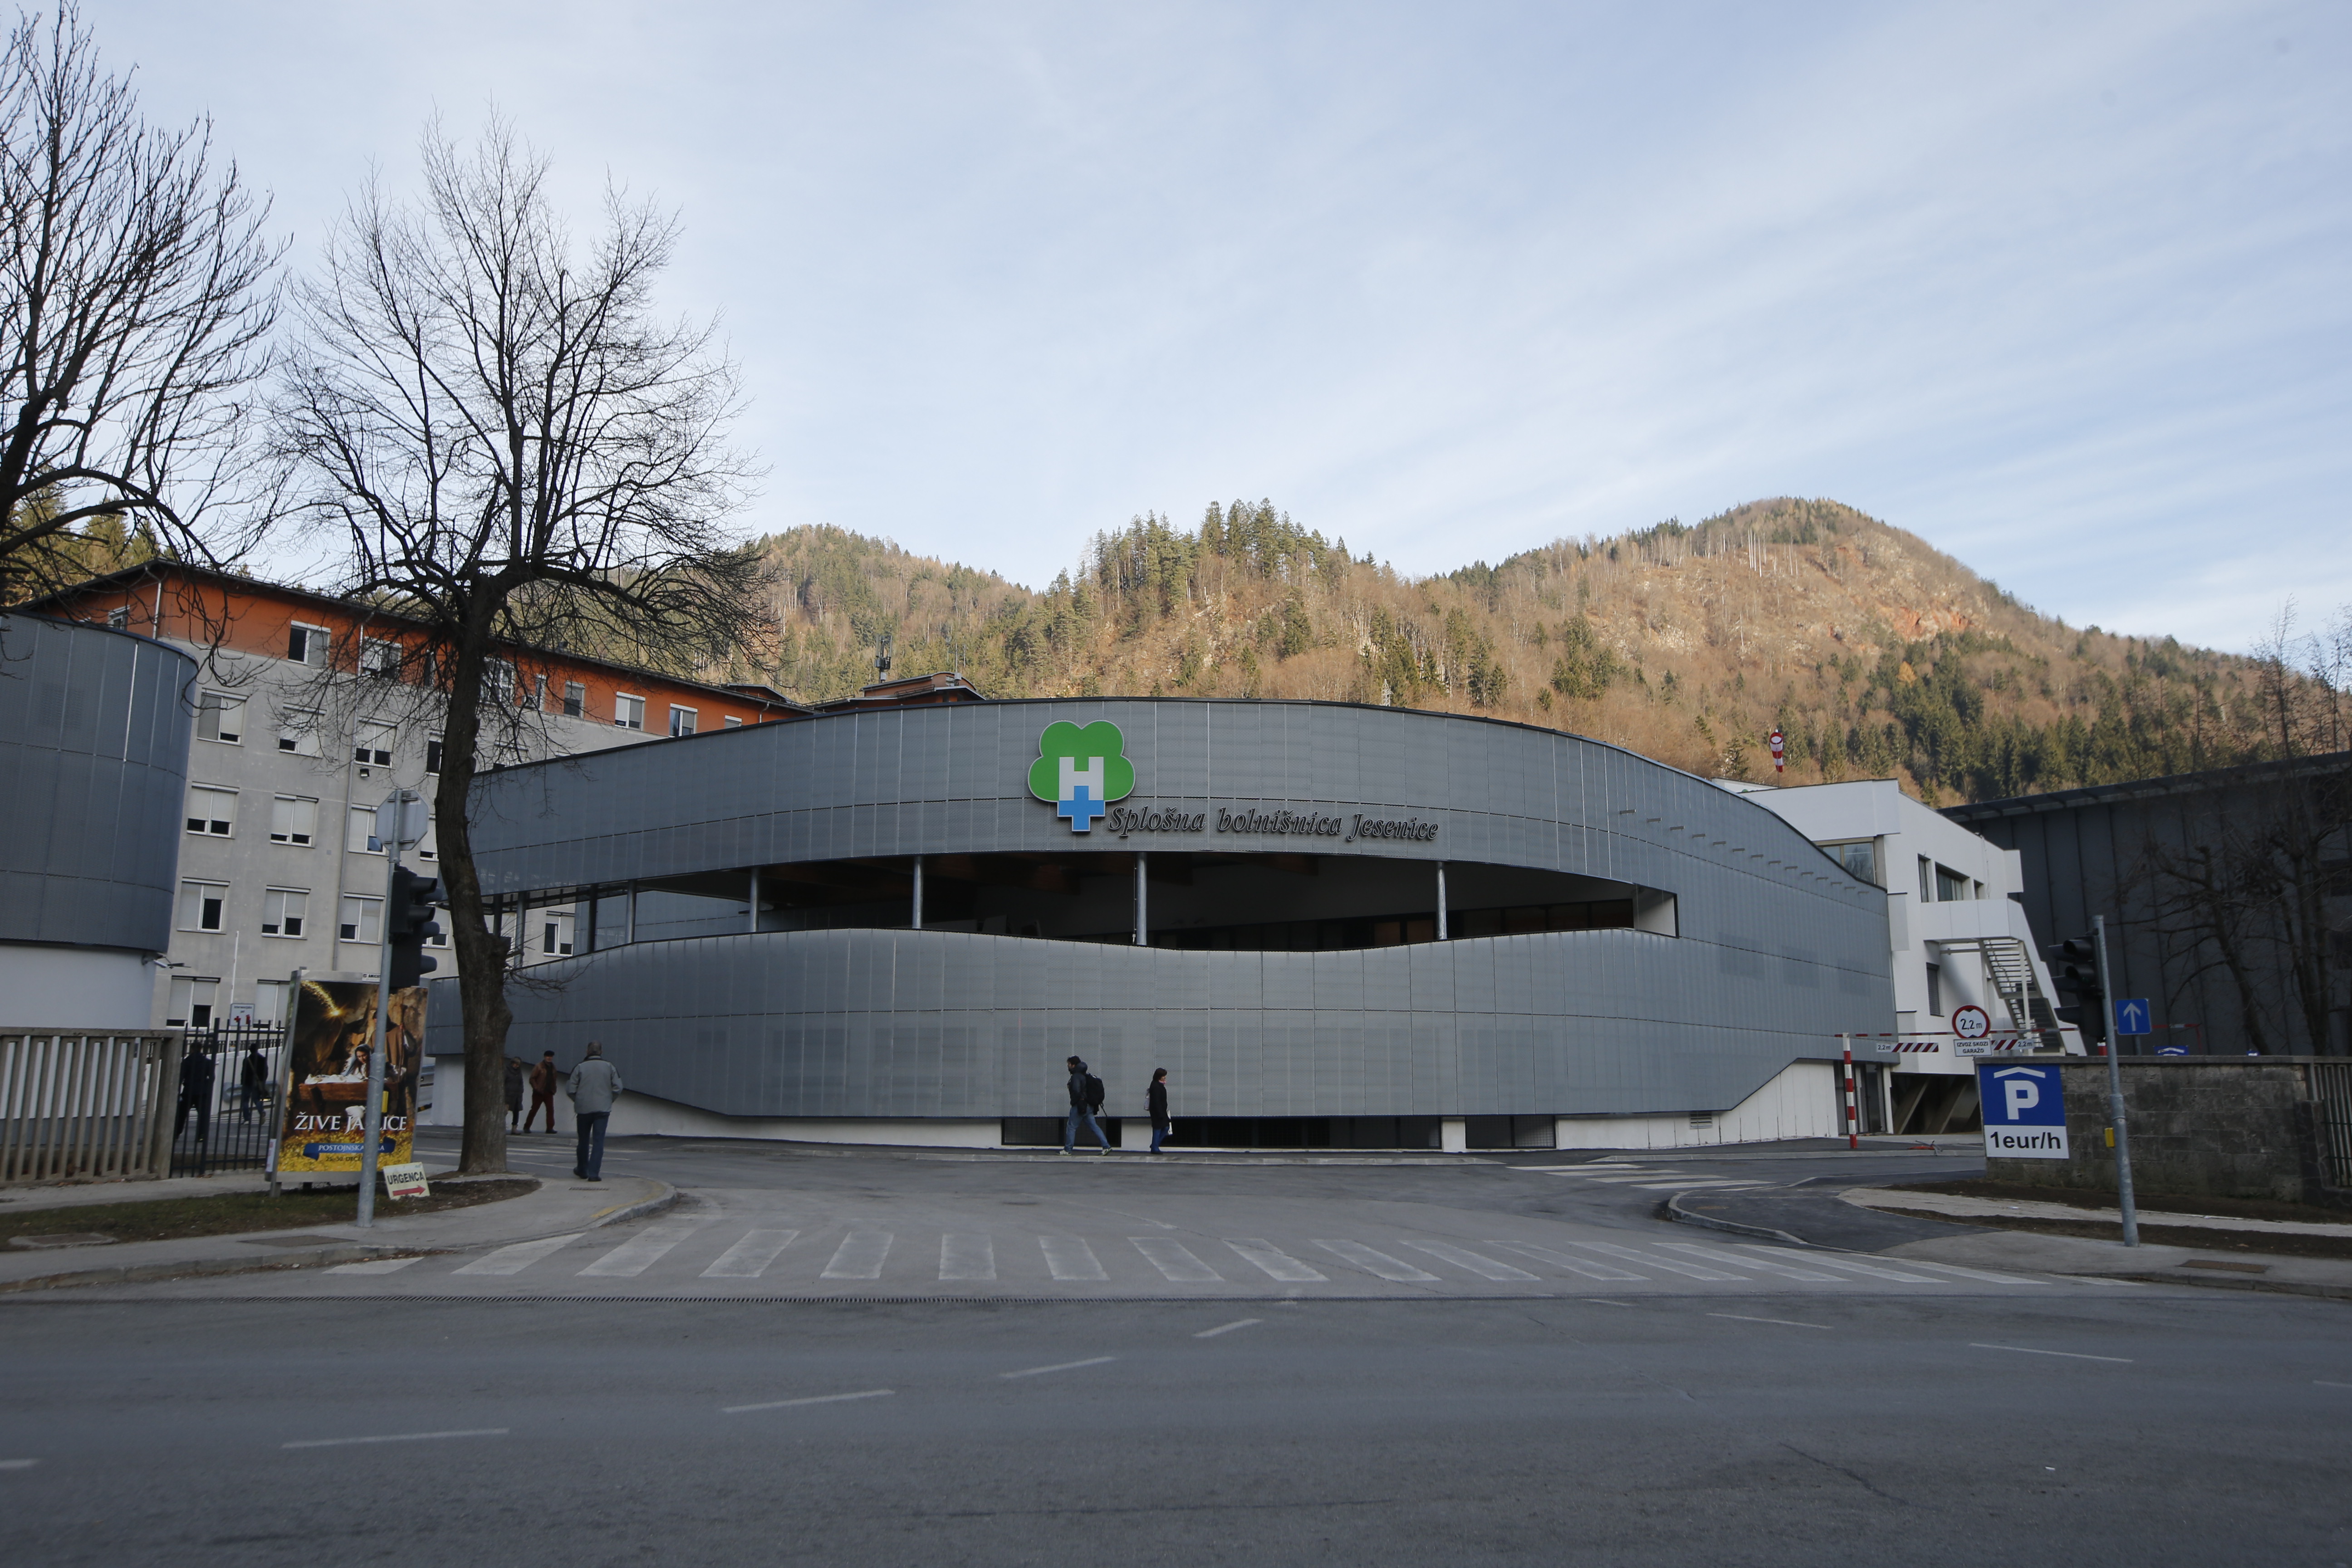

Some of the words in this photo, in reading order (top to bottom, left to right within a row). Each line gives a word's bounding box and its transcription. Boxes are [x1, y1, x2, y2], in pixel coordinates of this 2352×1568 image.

[1108, 806, 1205, 838] Splošna
[1217, 807, 1343, 835] bolnišnica
[1346, 813, 1439, 842] Jesenice
[1960, 1018, 1975, 1030] 2,2
[2004, 1080, 2039, 1120] P
[294, 1112, 341, 1130] ŽIVE
[344, 1116, 407, 1134] JAICE
[318, 1144, 364, 1152] POSTOJNSKA
[1990, 1131, 2061, 1149] 1eur/h
[387, 1171, 425, 1185] URGENCA
